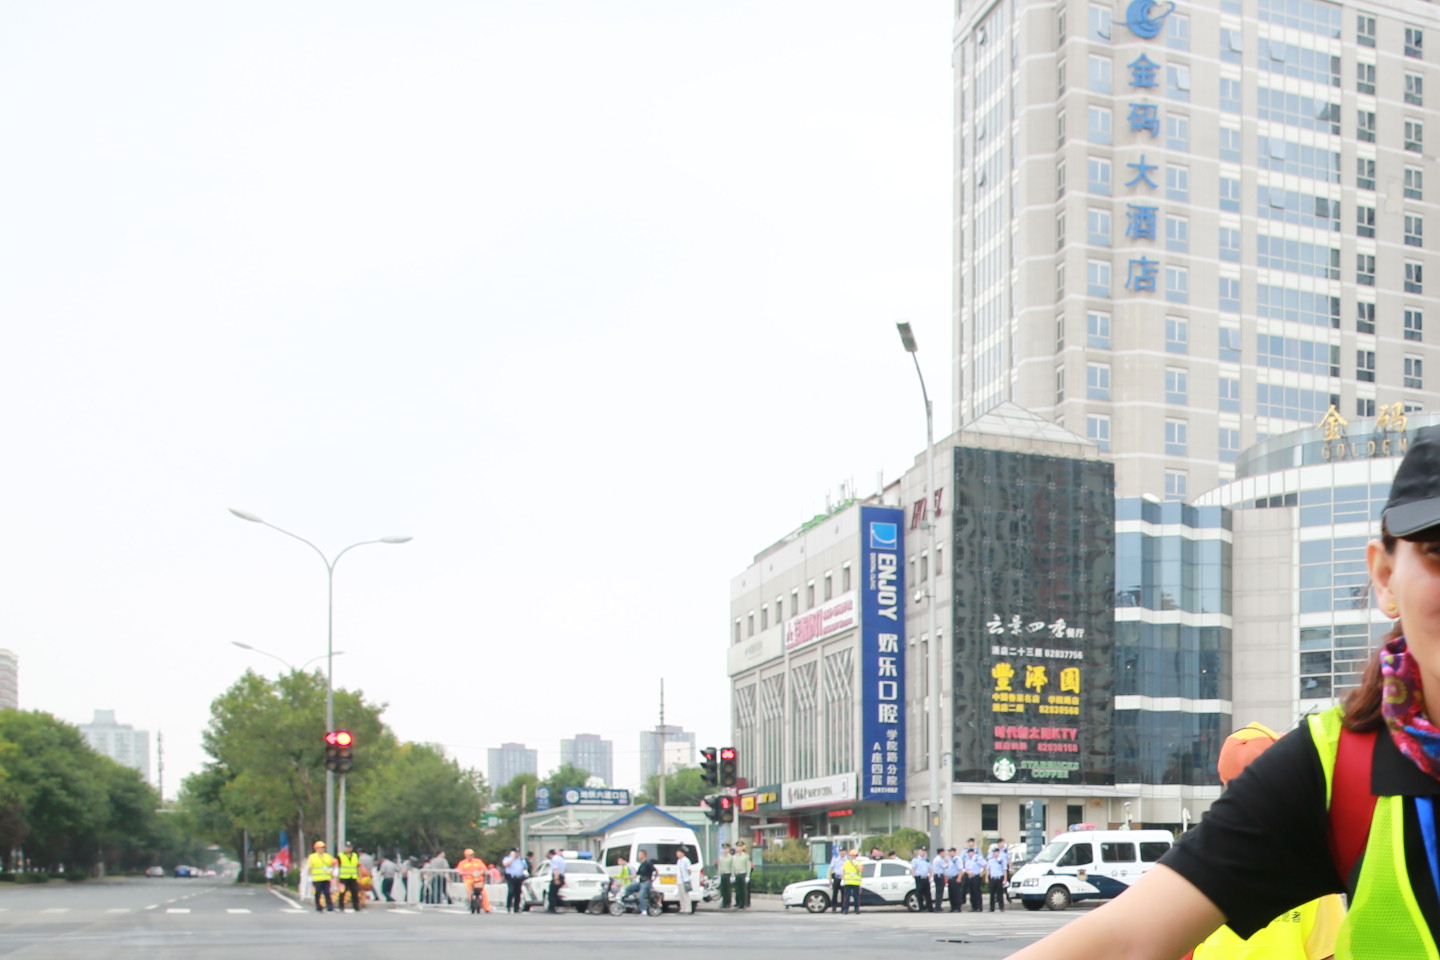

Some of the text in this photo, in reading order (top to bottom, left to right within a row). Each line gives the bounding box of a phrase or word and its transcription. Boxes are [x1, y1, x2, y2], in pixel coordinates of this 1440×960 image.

[1124, 53, 1161, 293] 金码大酒店
[1321, 437, 1408, 460] GOLDEN
[878, 553, 898, 621] ENJOY
[878, 633, 899, 723] 欢乐口腔
[886, 729, 899, 786] 学院路分院
[1020, 760, 1080, 771] STARBUCKS
[1031, 770, 1069, 779] COFFEE
[1111, 869, 1128, 877] 公安
[881, 882, 899, 890] 公安
